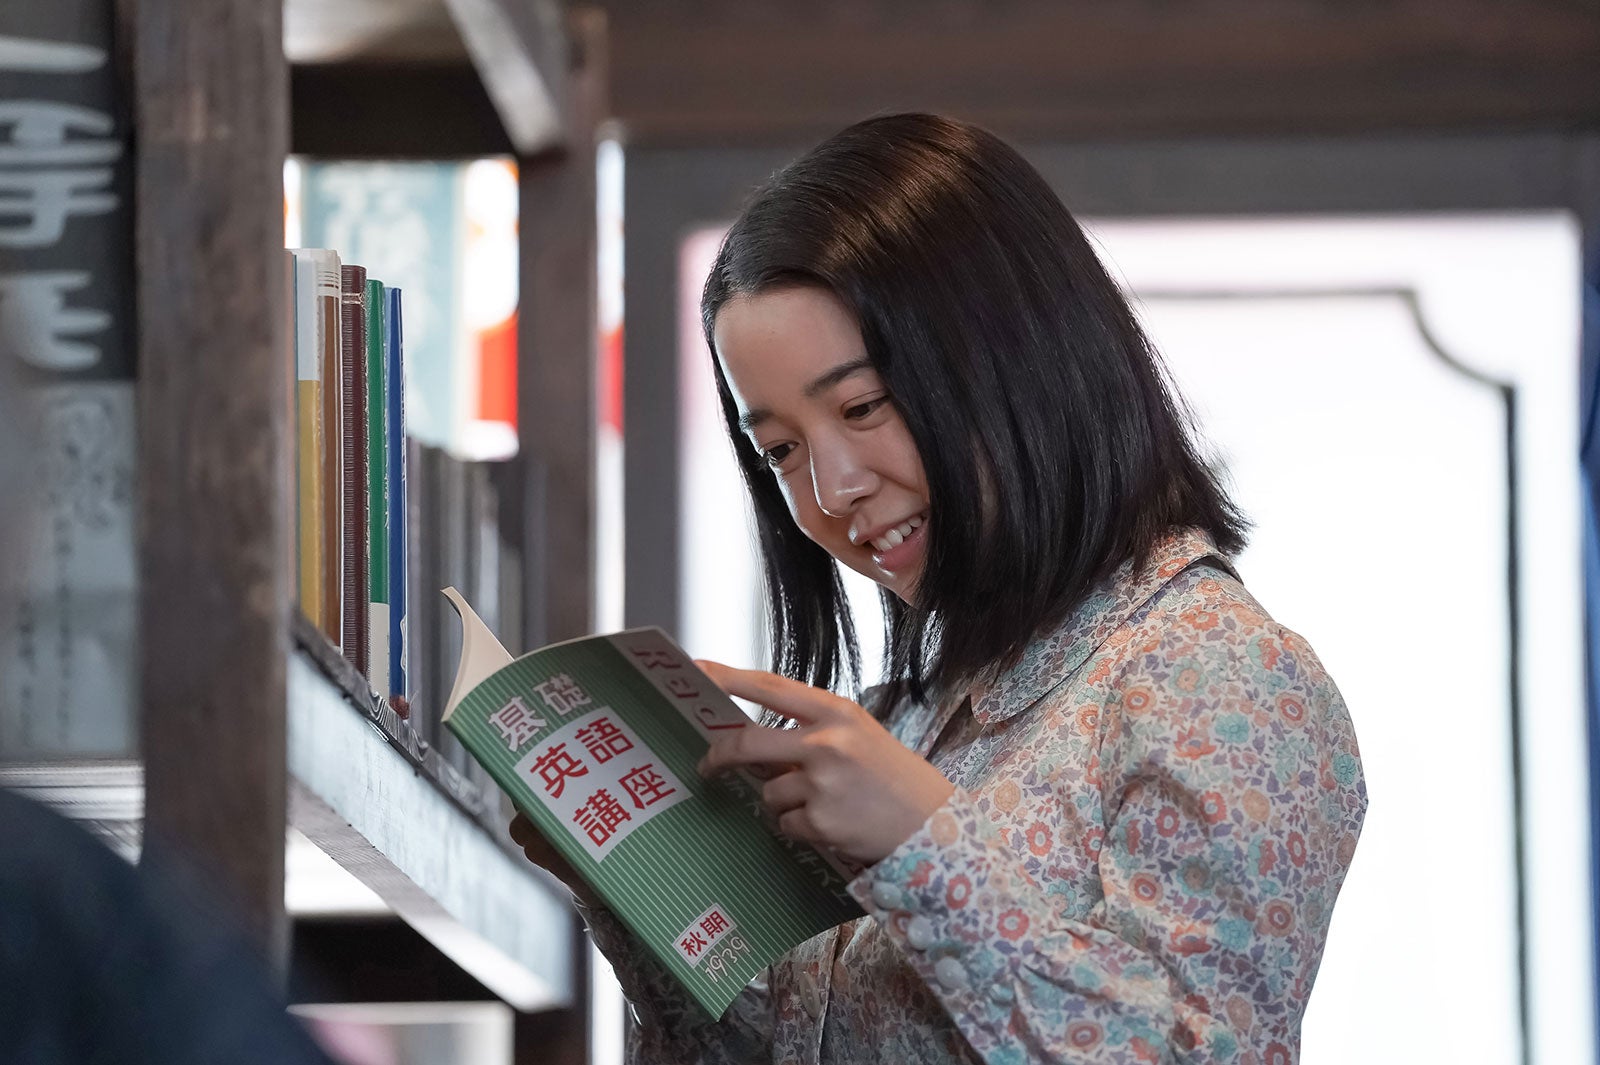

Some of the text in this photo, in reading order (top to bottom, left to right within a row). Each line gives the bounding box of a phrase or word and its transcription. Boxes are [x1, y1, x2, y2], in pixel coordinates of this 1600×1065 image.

[488, 673, 593, 752] 基礎
[629, 646, 747, 731] Rad
[530, 717, 635, 799] 英語
[573, 764, 677, 848] 講座
[681, 911, 730, 957] 秋期
[705, 936, 751, 983] 1939
